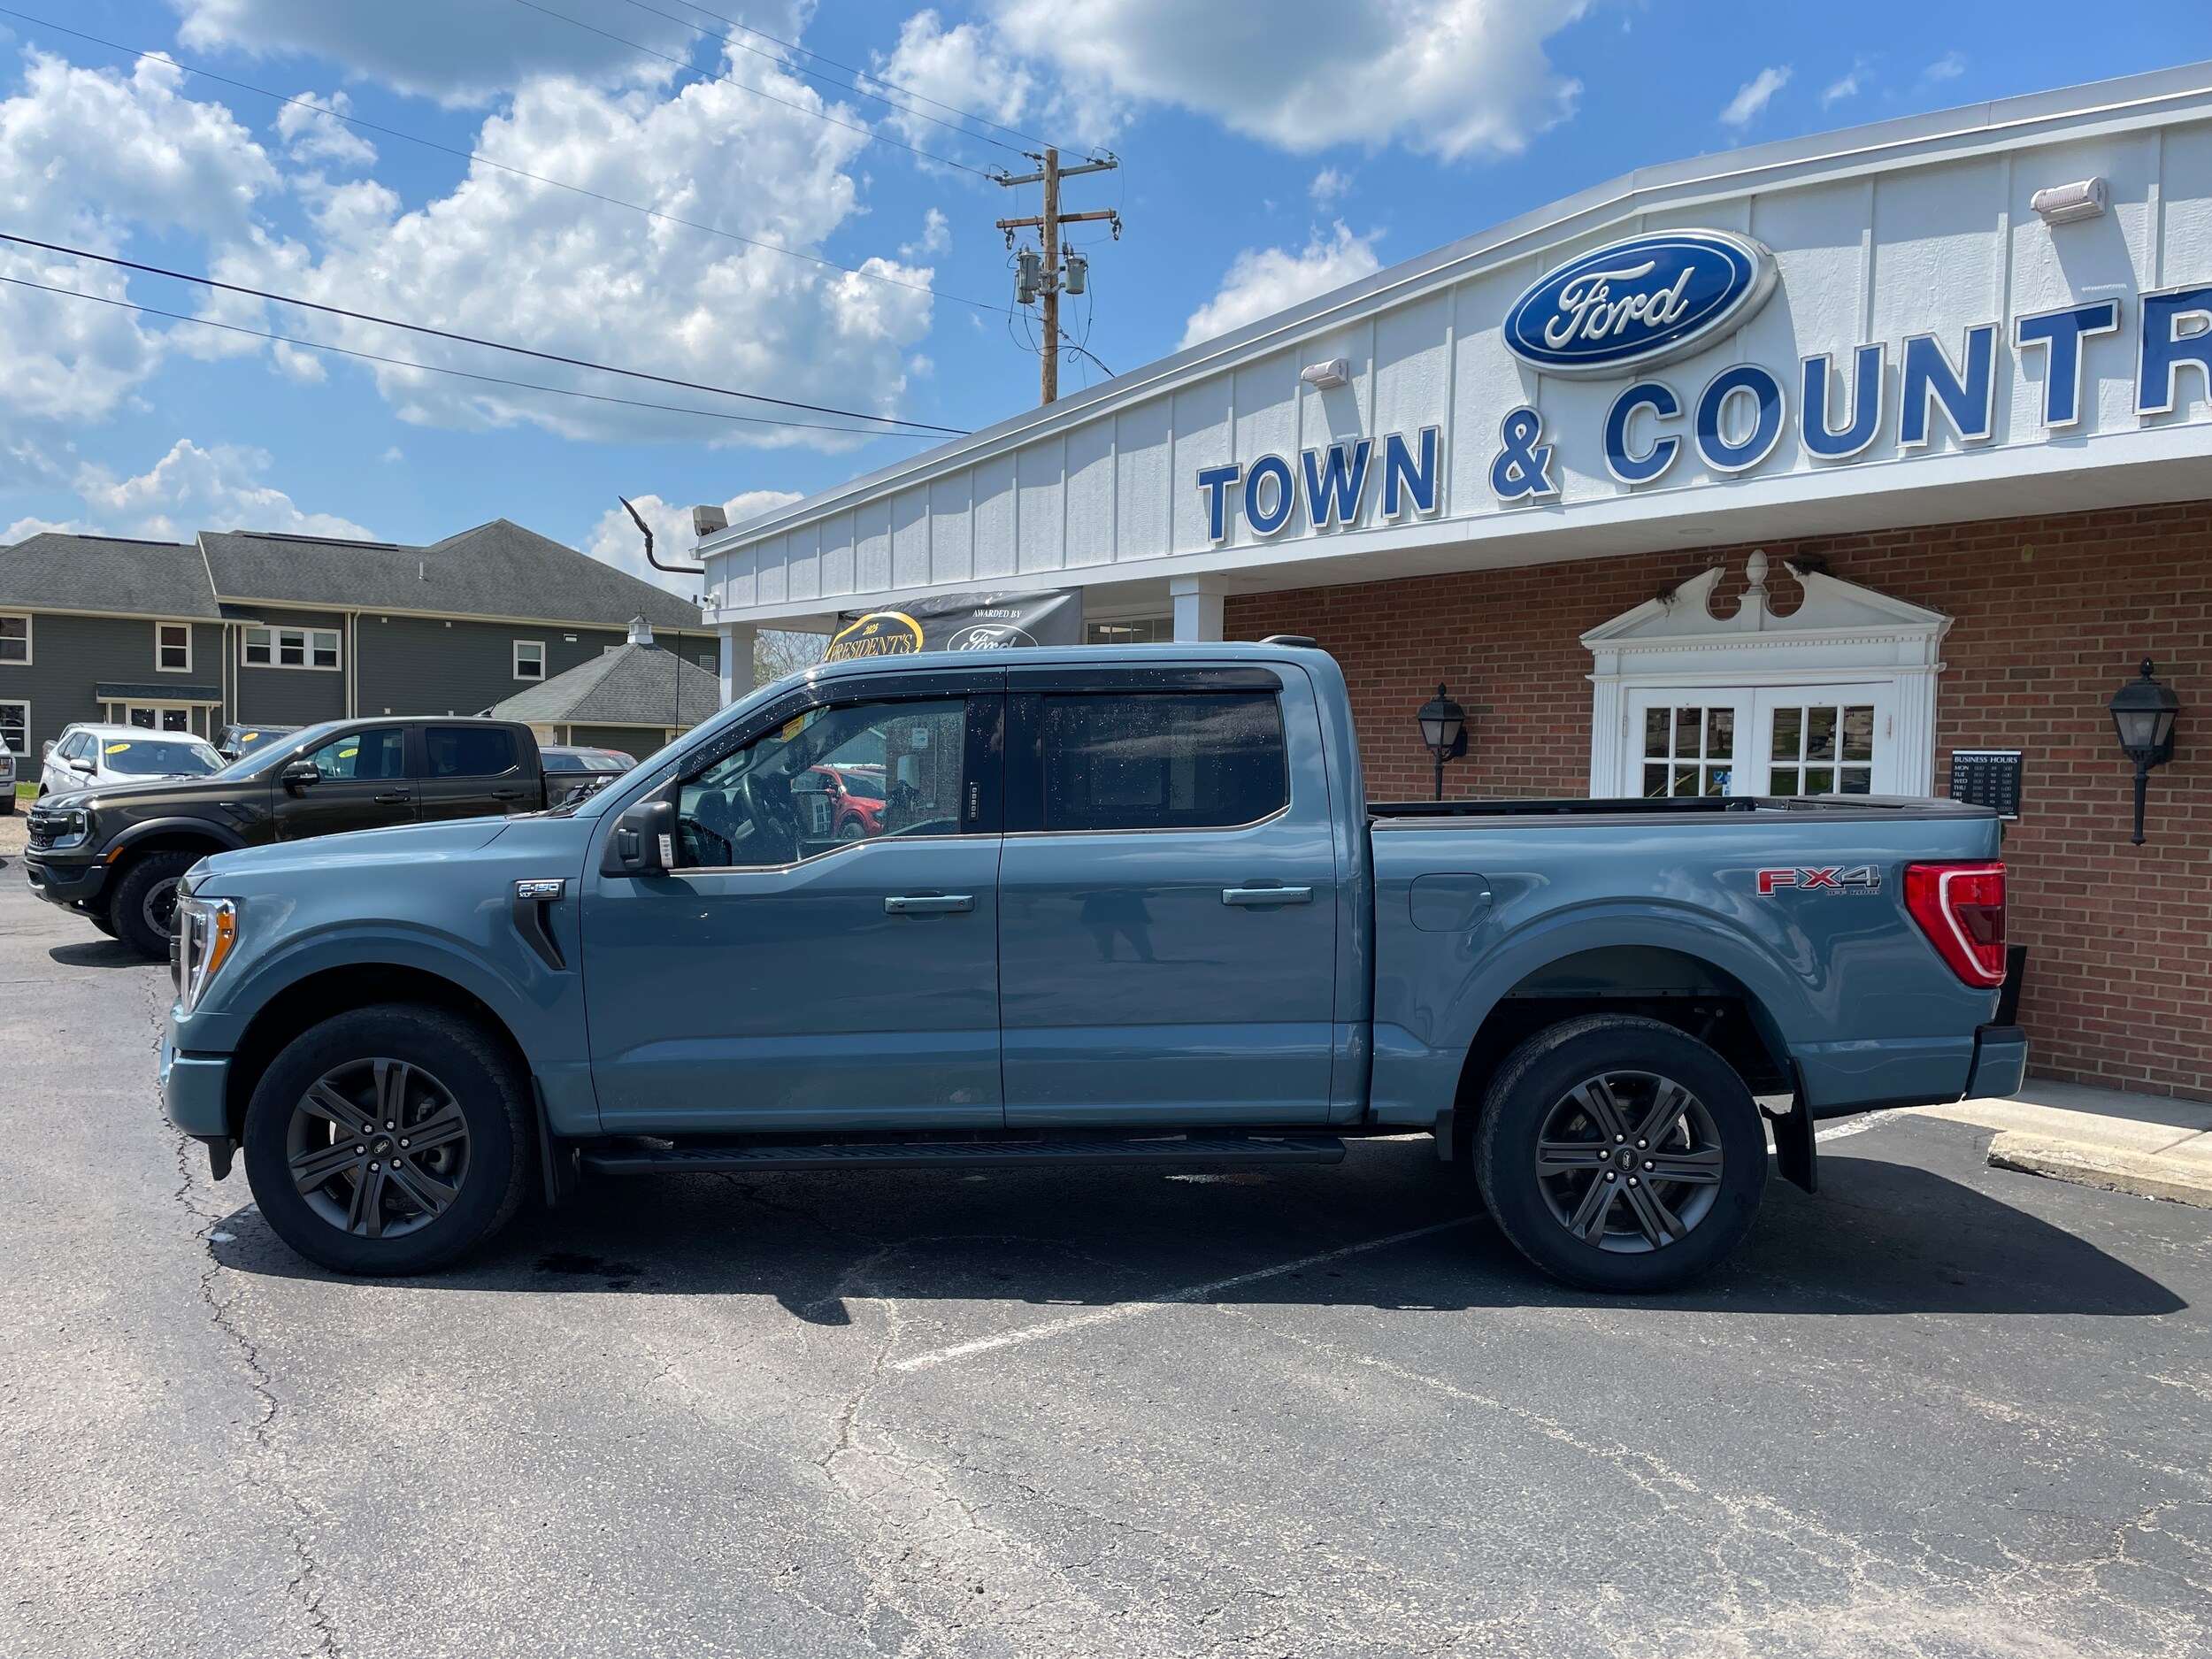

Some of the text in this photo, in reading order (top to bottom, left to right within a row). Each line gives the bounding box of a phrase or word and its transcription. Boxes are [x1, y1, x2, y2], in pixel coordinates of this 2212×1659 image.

[1544, 260, 1695, 349] Ford
[1196, 282, 2212, 542] TOWN & COUNTR
[972, 609, 1023, 618] AWARDED BY
[830, 634, 913, 662] PRESIDENT'S
[518, 883, 560, 892] F-150
[1757, 865, 1882, 897] FX4
